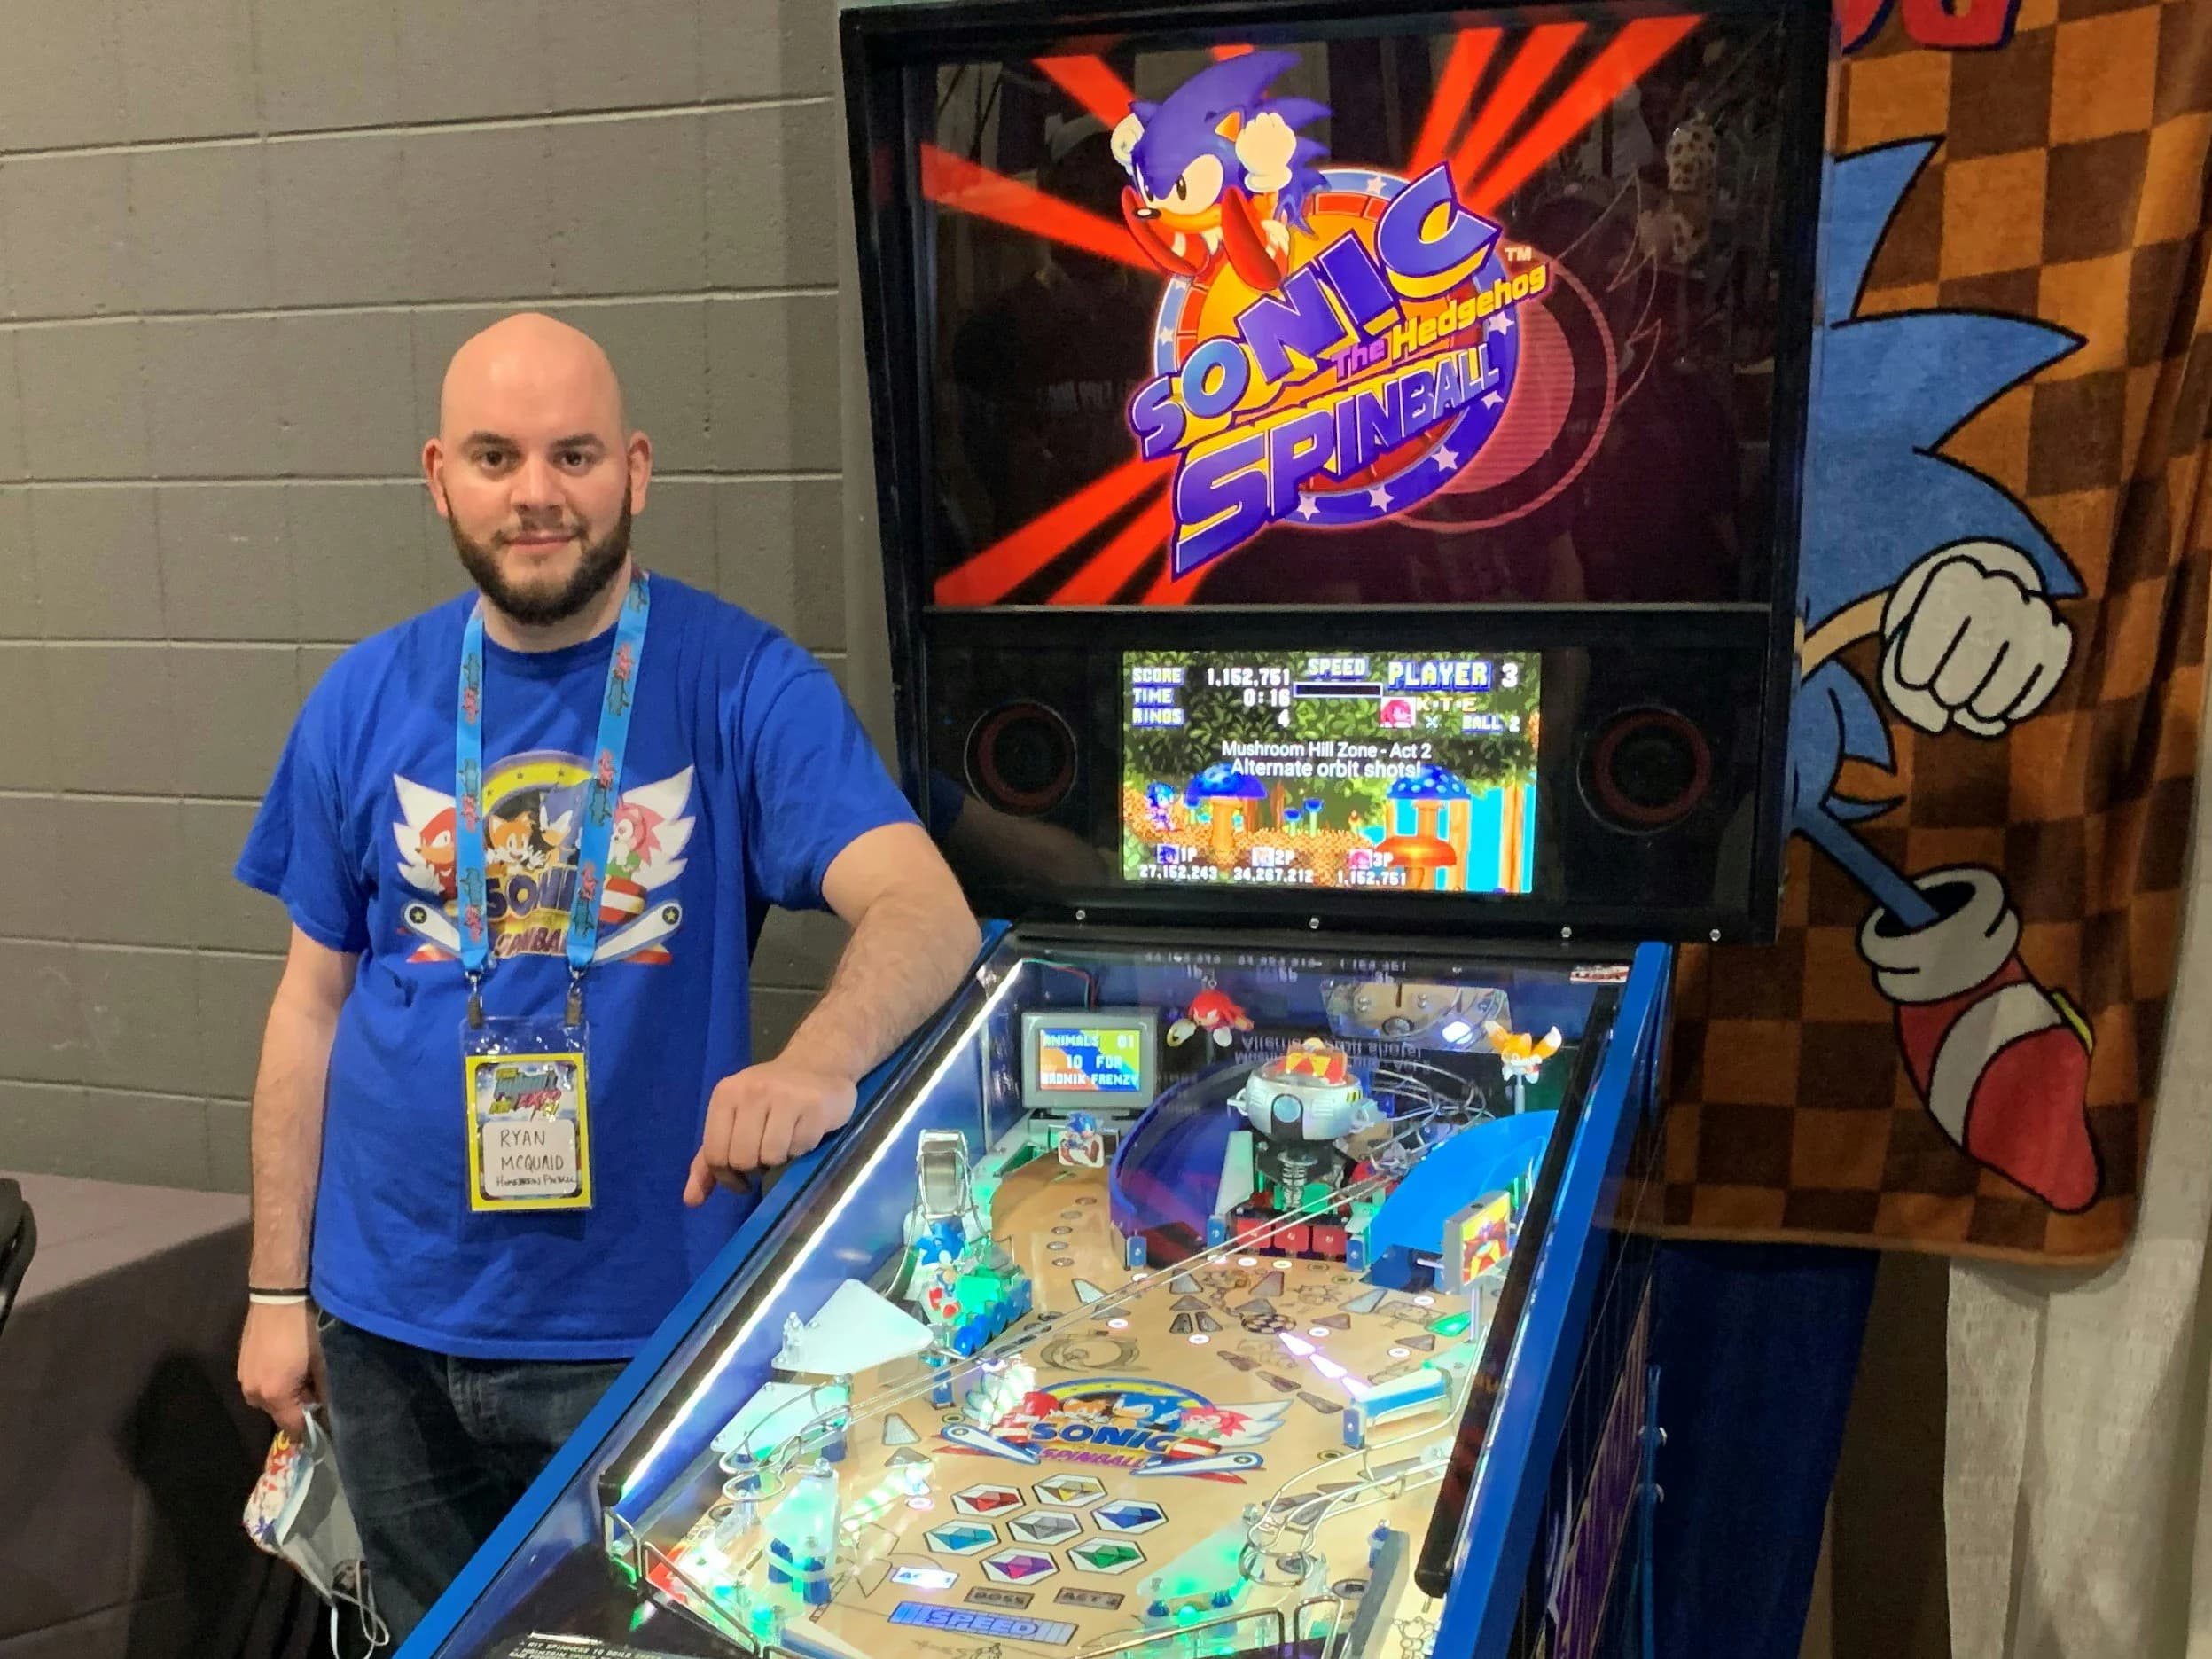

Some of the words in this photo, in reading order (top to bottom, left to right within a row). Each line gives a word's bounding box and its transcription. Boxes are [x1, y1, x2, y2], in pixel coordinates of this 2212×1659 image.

[1126, 160, 1503, 462] SONIC
[1331, 338, 1387, 379] The
[1390, 263, 1550, 360] Hedgehog
[1172, 342, 1501, 582] SPINBALL
[1132, 666, 1184, 685] SCORE
[1307, 657, 1368, 678] SPEED
[1387, 660, 1493, 692] PLAYER
[1501, 661, 1519, 688] 3
[1132, 687, 1174, 706] TIME
[1132, 708, 1184, 726] RINGS
[1278, 708, 1291, 728] 4
[1461, 713, 1504, 733] BALL
[1509, 716, 1520, 733] 2
[1222, 740, 1305, 757] Mushroom
[1309, 741, 1334, 758] Hill
[1337, 742, 1378, 759] Zone
[1389, 743, 1418, 759] Act
[1420, 743, 1432, 760] 2
[1231, 758, 1313, 777] Alternate
[1317, 759, 1360, 779] orbit
[1364, 761, 1422, 779] shots!
[1179, 848, 1198, 863] 1P
[1275, 850, 1295, 865] 2P
[1043, 1034, 1100, 1048] ANIMALS
[1067, 1054, 1083, 1069] 10
[1096, 1055, 1123, 1069] FOR
[1091, 1073, 1139, 1086] FRENZY
[500, 1128, 546, 1148] RYAN
[501, 1154, 565, 1172] MCQUAID
[1029, 1420, 1178, 1455] SONIC
[926, 1608, 1039, 1637] SPEED
